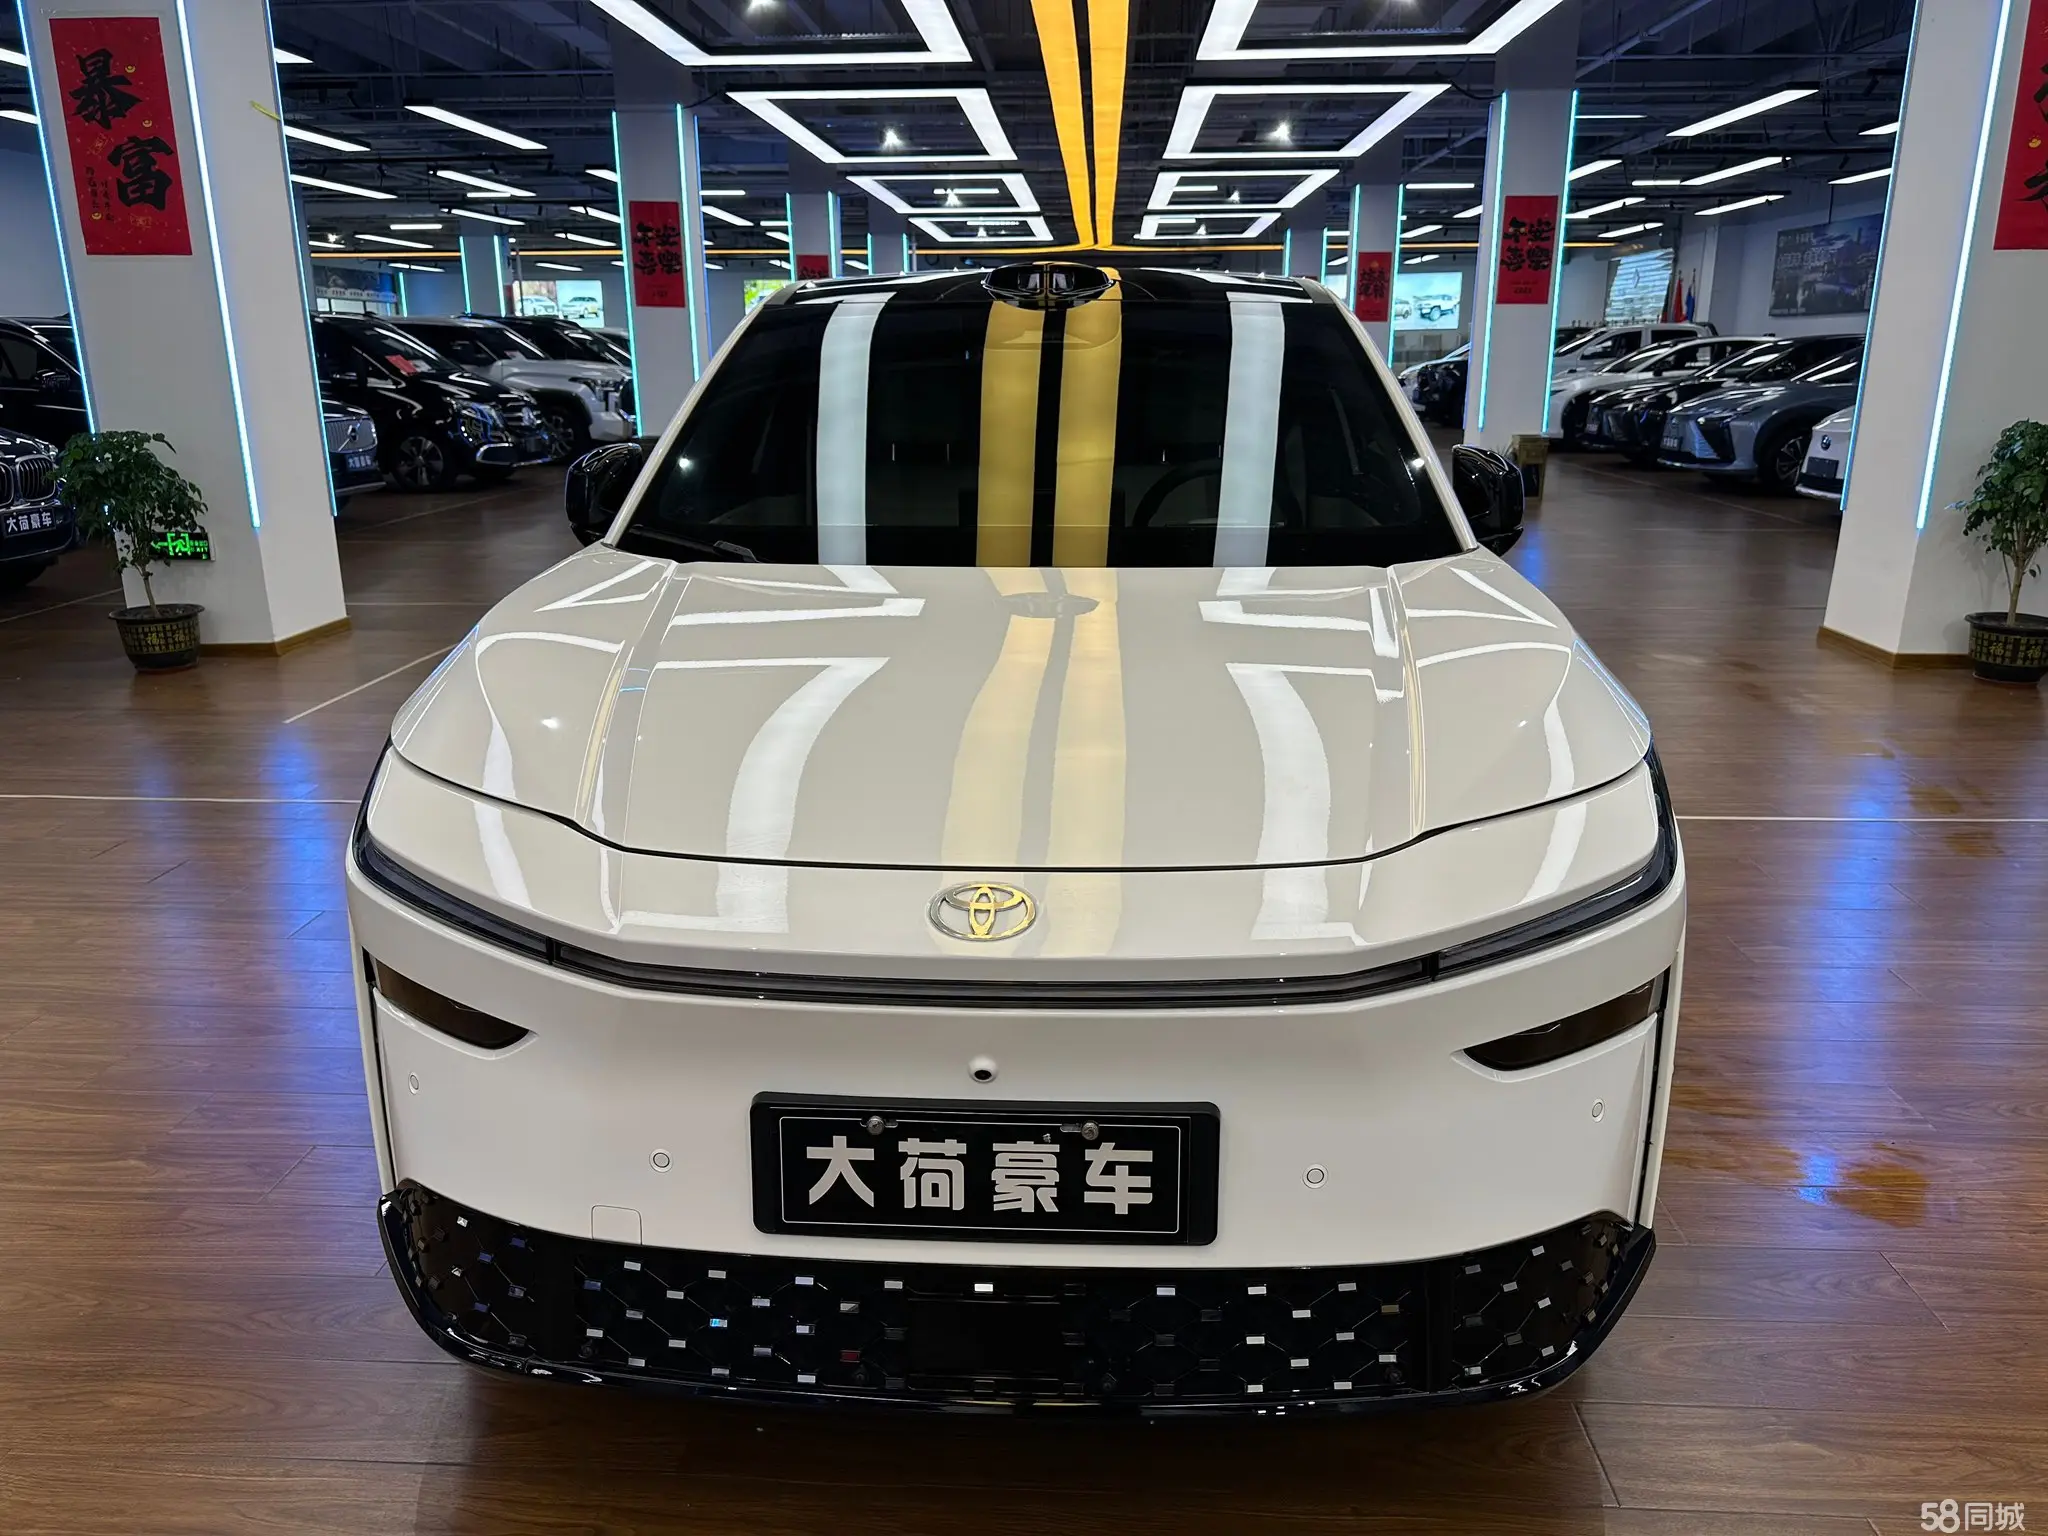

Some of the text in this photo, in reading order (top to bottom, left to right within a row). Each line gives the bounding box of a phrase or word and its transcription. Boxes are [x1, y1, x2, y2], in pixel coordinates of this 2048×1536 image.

[68, 48, 175, 211] 暴富
[806, 1135, 1154, 1215] 大荷豪车
